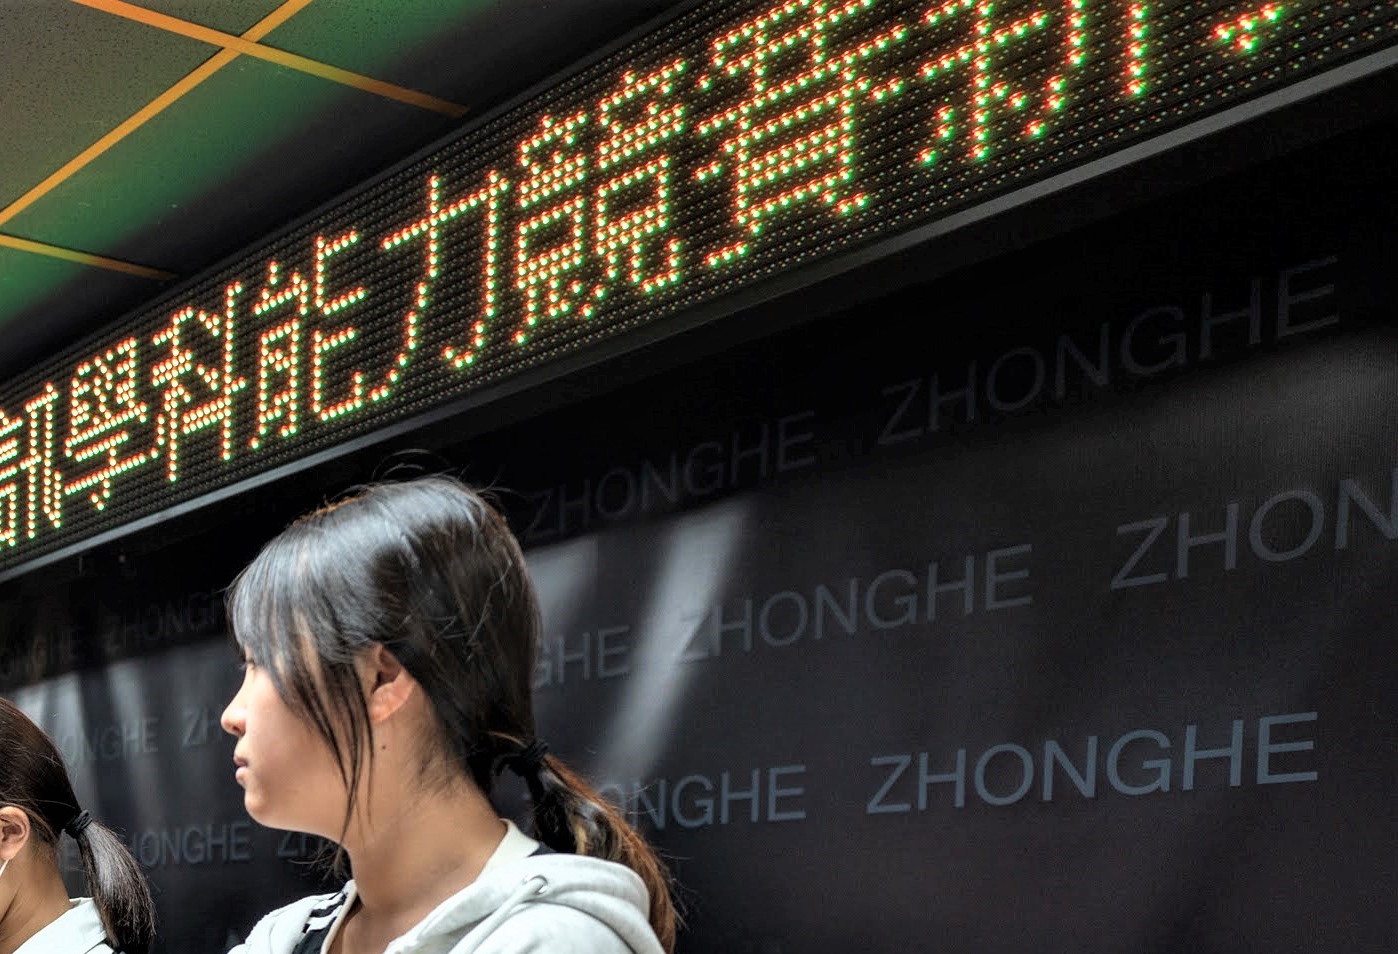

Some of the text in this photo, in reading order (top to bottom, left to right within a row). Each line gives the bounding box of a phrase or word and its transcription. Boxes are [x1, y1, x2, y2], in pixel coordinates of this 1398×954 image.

[524, 409, 816, 542] ZHONGHE
[875, 255, 1340, 447] ZHONGHE
[679, 545, 1033, 664] ZHONGHE
[132, 819, 252, 867] ONGHE
[866, 712, 1319, 814] ZHONGHE
